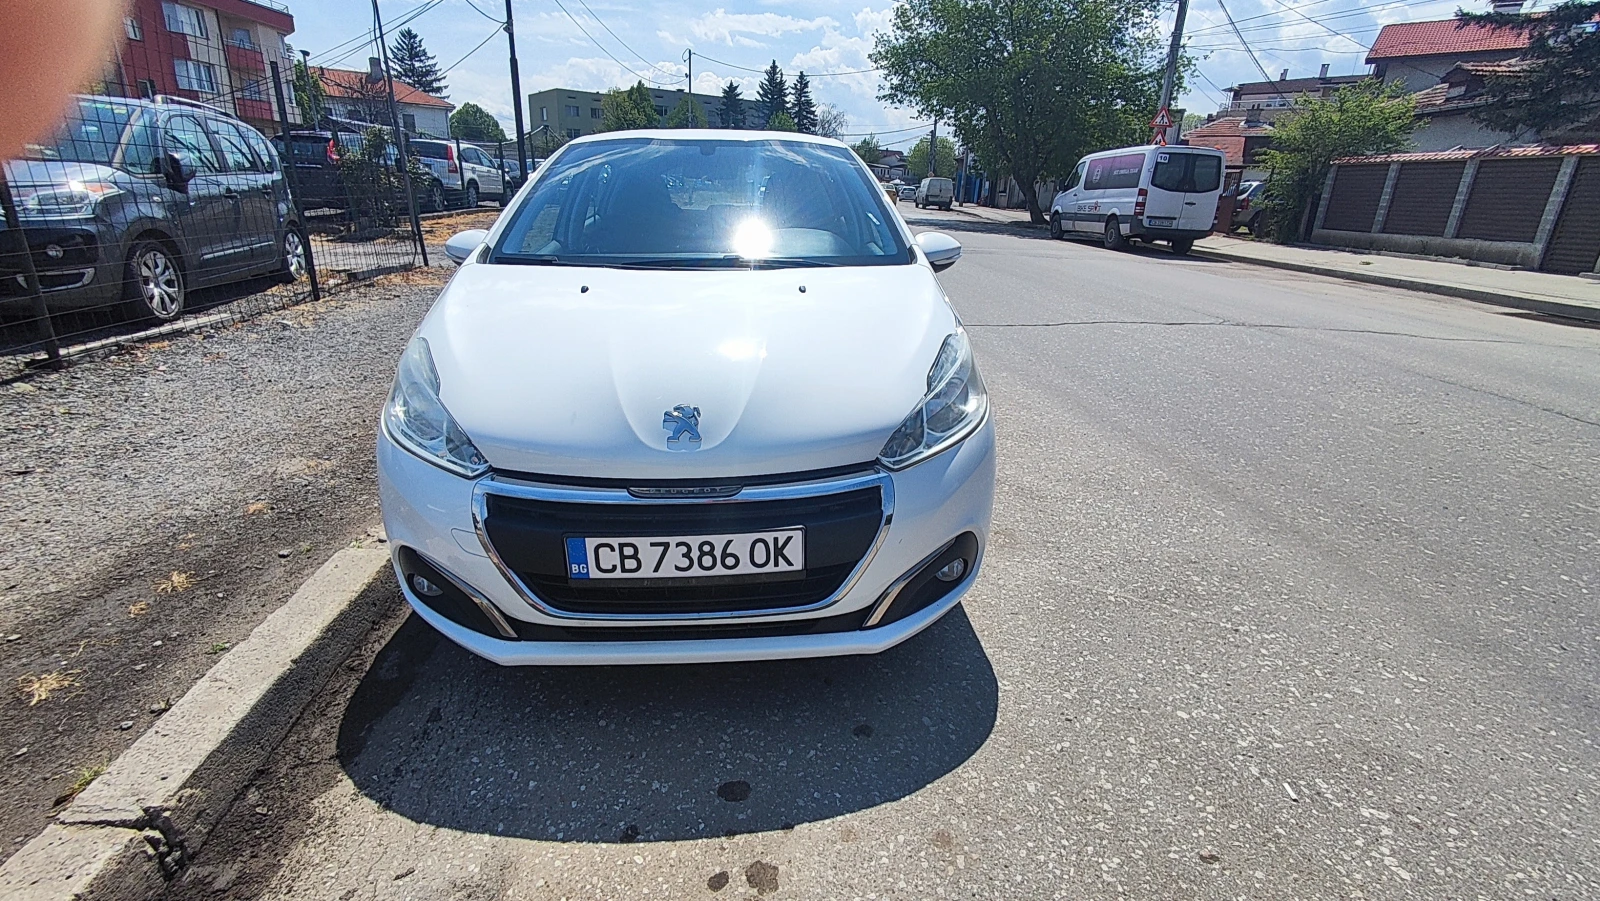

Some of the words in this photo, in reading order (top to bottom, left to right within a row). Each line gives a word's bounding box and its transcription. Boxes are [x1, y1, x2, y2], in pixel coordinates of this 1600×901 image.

[649, 486, 722, 494] PEUGEOT
[571, 563, 588, 574] BG
[593, 542, 643, 574] CB
[649, 539, 741, 573] 7386
[749, 535, 795, 569] OK
